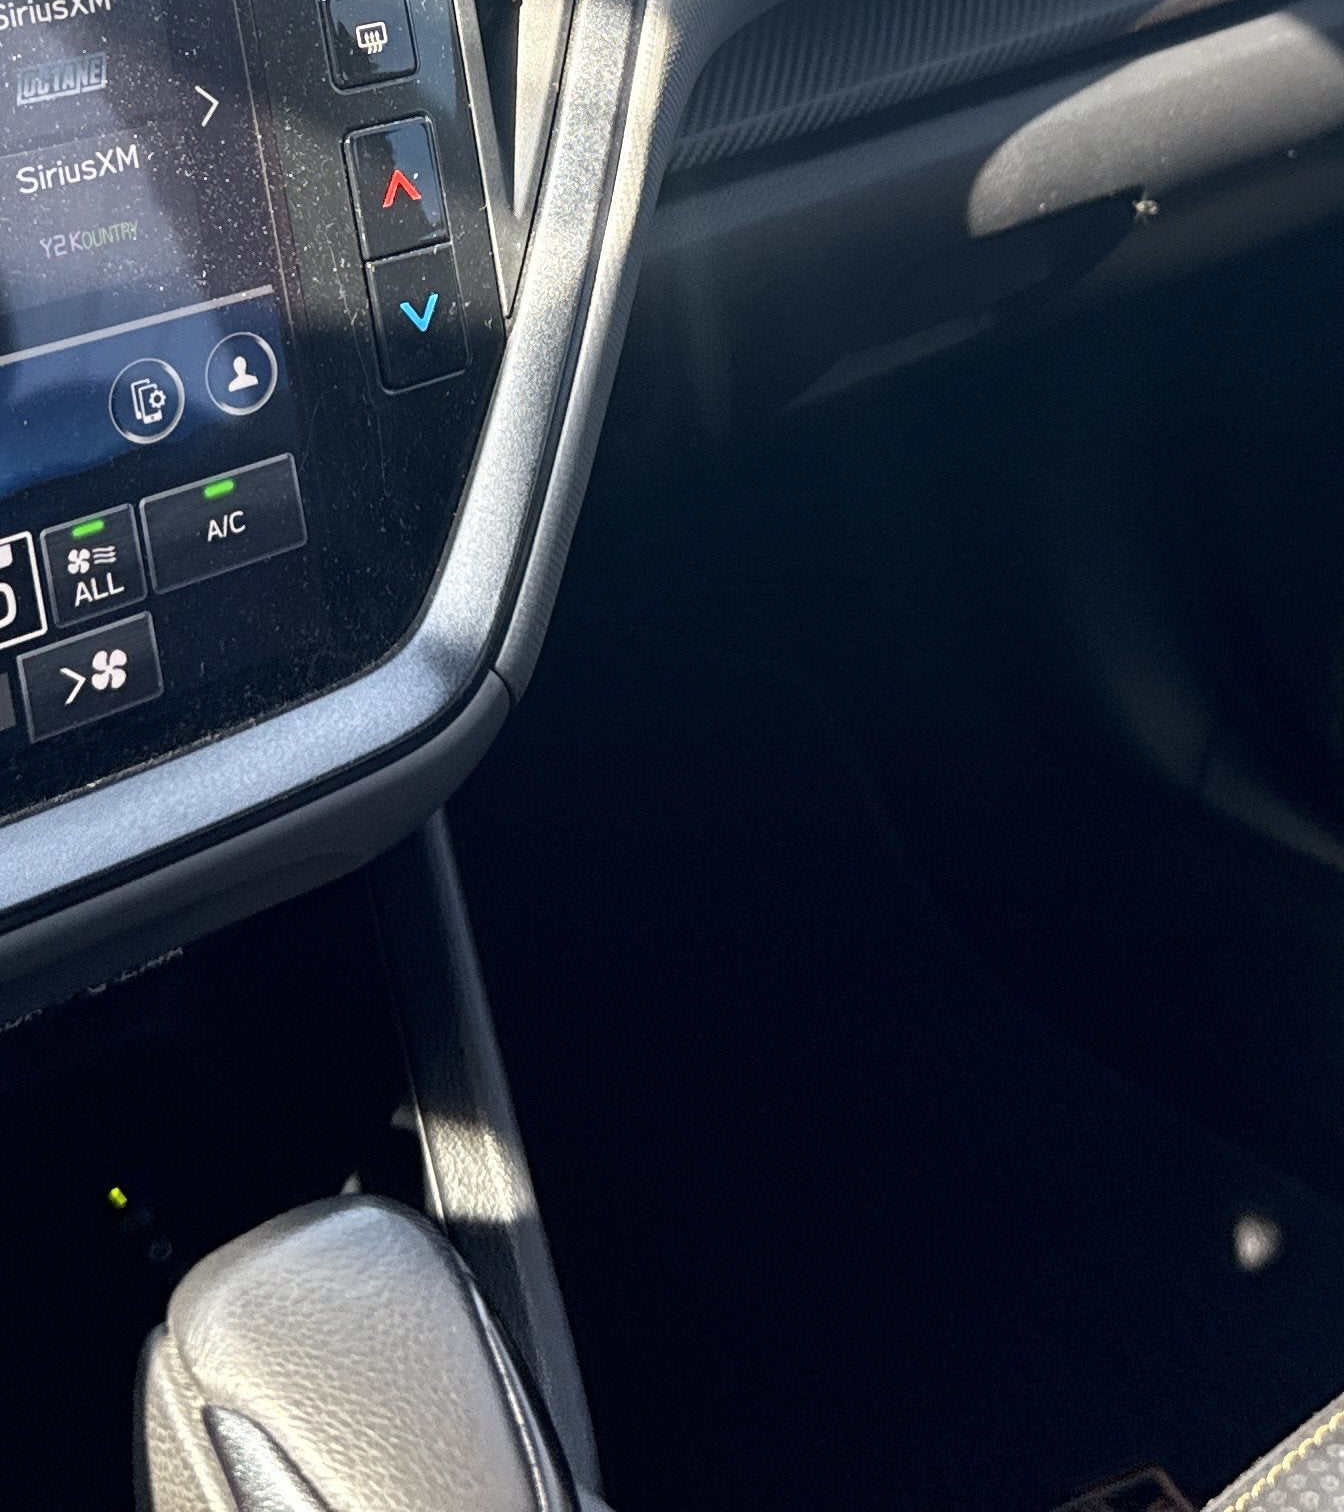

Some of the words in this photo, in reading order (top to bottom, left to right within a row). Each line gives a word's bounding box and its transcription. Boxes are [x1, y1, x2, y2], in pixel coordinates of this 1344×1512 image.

[22, 56, 102, 98] OCTANE
[16, 144, 140, 194] SiriusXM
[206, 510, 247, 543] A/C
[73, 572, 126, 608] ALL
